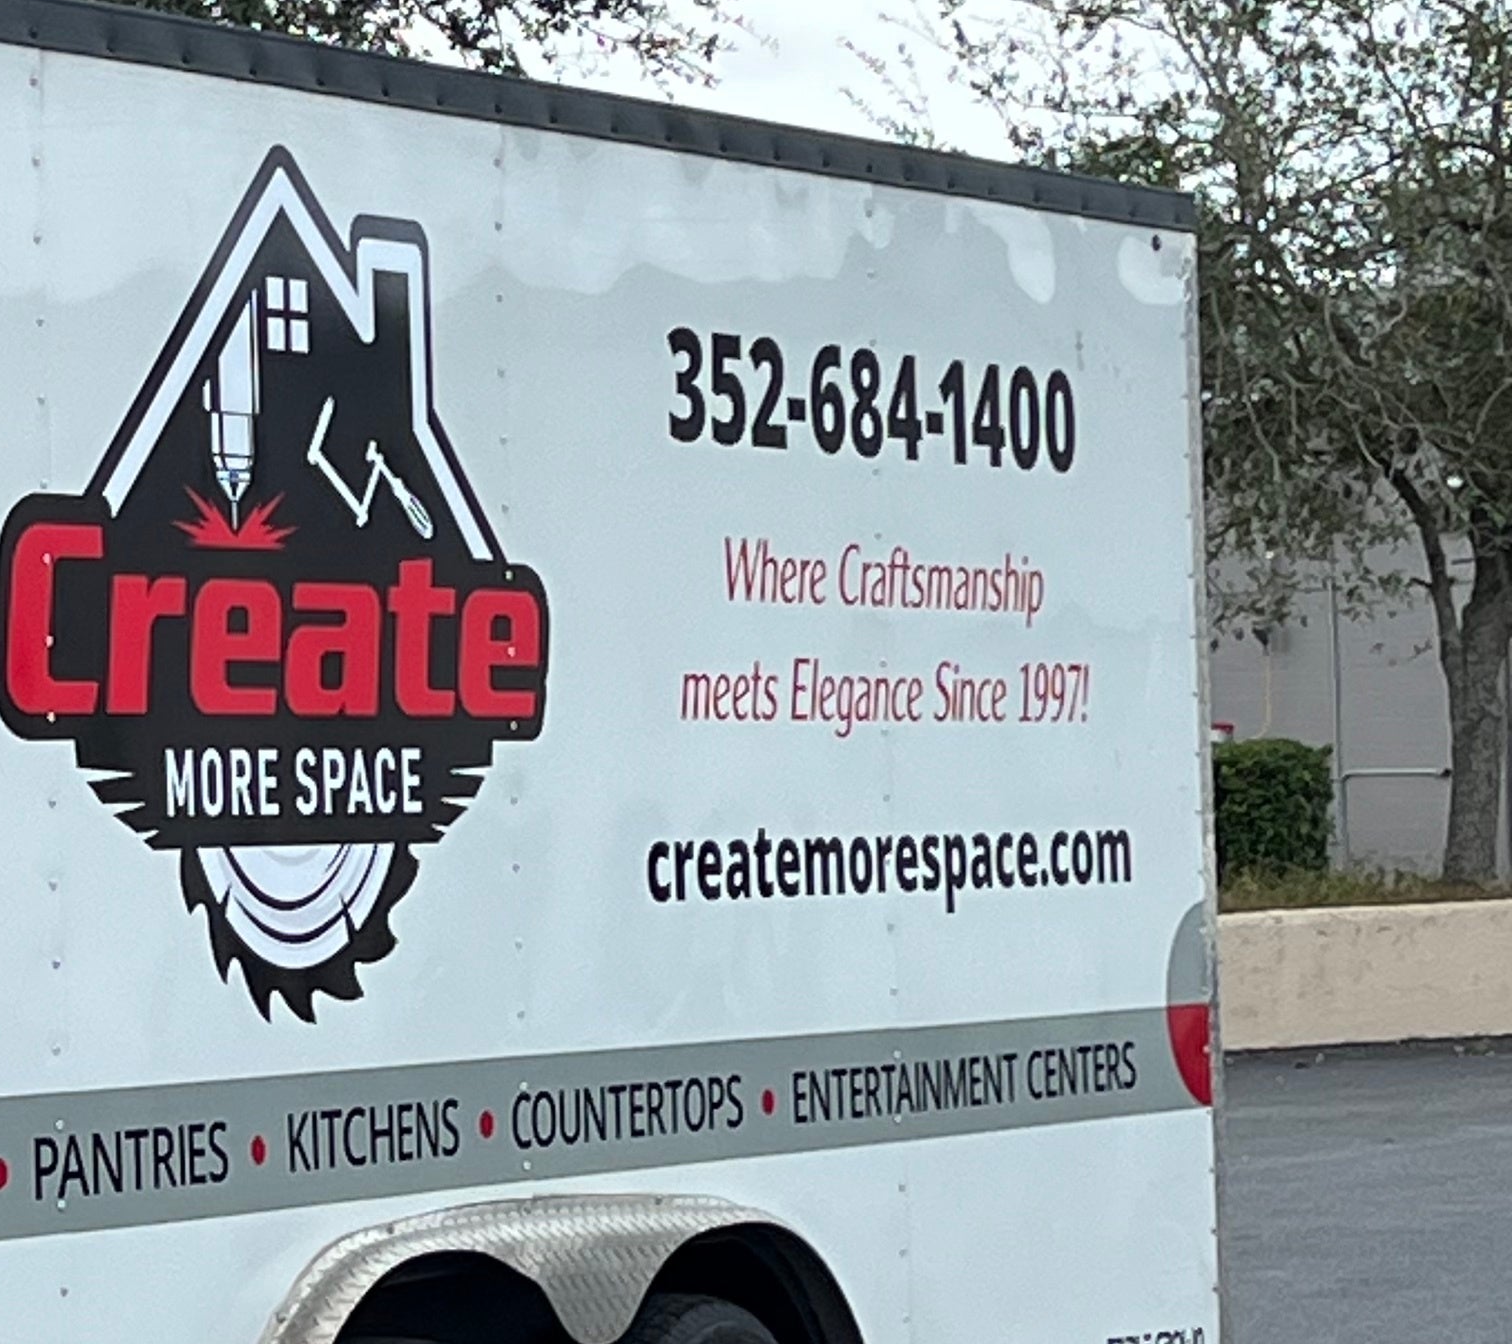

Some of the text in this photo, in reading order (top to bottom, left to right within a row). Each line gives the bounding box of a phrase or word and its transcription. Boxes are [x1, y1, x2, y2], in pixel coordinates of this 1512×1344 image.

[666, 327, 1076, 474] 352-684-1400
[5, 522, 542, 718] Create
[724, 537, 1044, 627] Where Craftsmanship
[681, 658, 1091, 738] meets Elegance Since 1997!
[164, 746, 424, 818] MORE SPACE
[647, 828, 1132, 914] createmorespace.com
[33, 1121, 230, 1202] PANTRIES
[287, 1097, 461, 1174] KITCHENS
[510, 1073, 745, 1151] COUNTERTOPS
[792, 1047, 1018, 1124] ENTERTAINMENT
[1026, 1041, 1138, 1102] CENTERS
